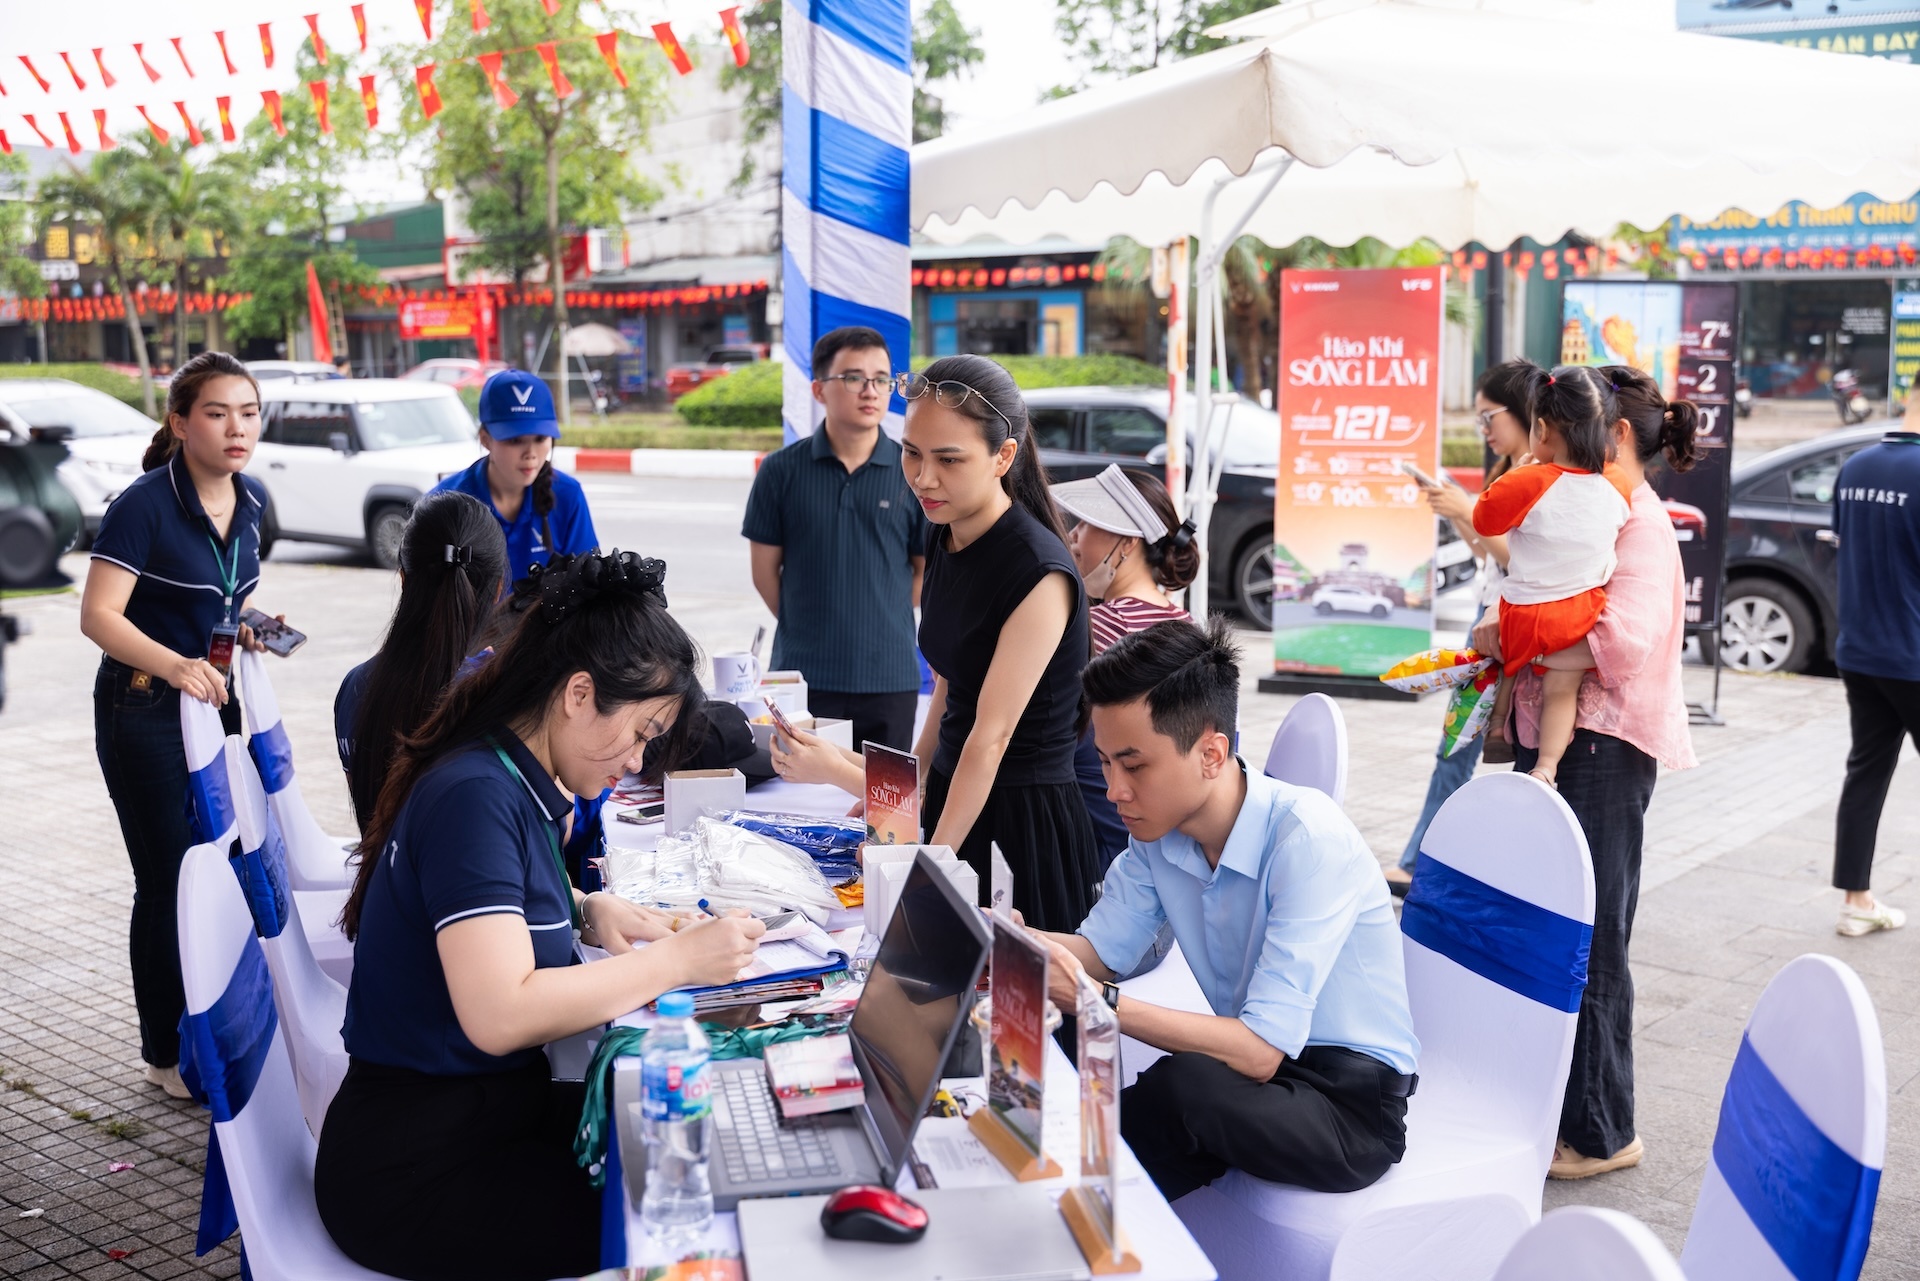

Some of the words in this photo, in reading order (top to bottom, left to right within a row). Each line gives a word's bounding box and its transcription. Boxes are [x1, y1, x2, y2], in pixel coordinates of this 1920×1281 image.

[1873, 31, 1919, 51] BAY
[1323, 336, 1366, 358] Hào
[1368, 336, 1404, 358] Khí
[1288, 355, 1363, 386] SÔNG
[1366, 359, 1428, 386] LAM
[1698, 364, 1717, 393] 2
[1332, 405, 1391, 440] 121
[1840, 487, 1908, 507] VINFAST
[871, 785, 893, 806] SÔNG
[893, 793, 912, 812] LAM
